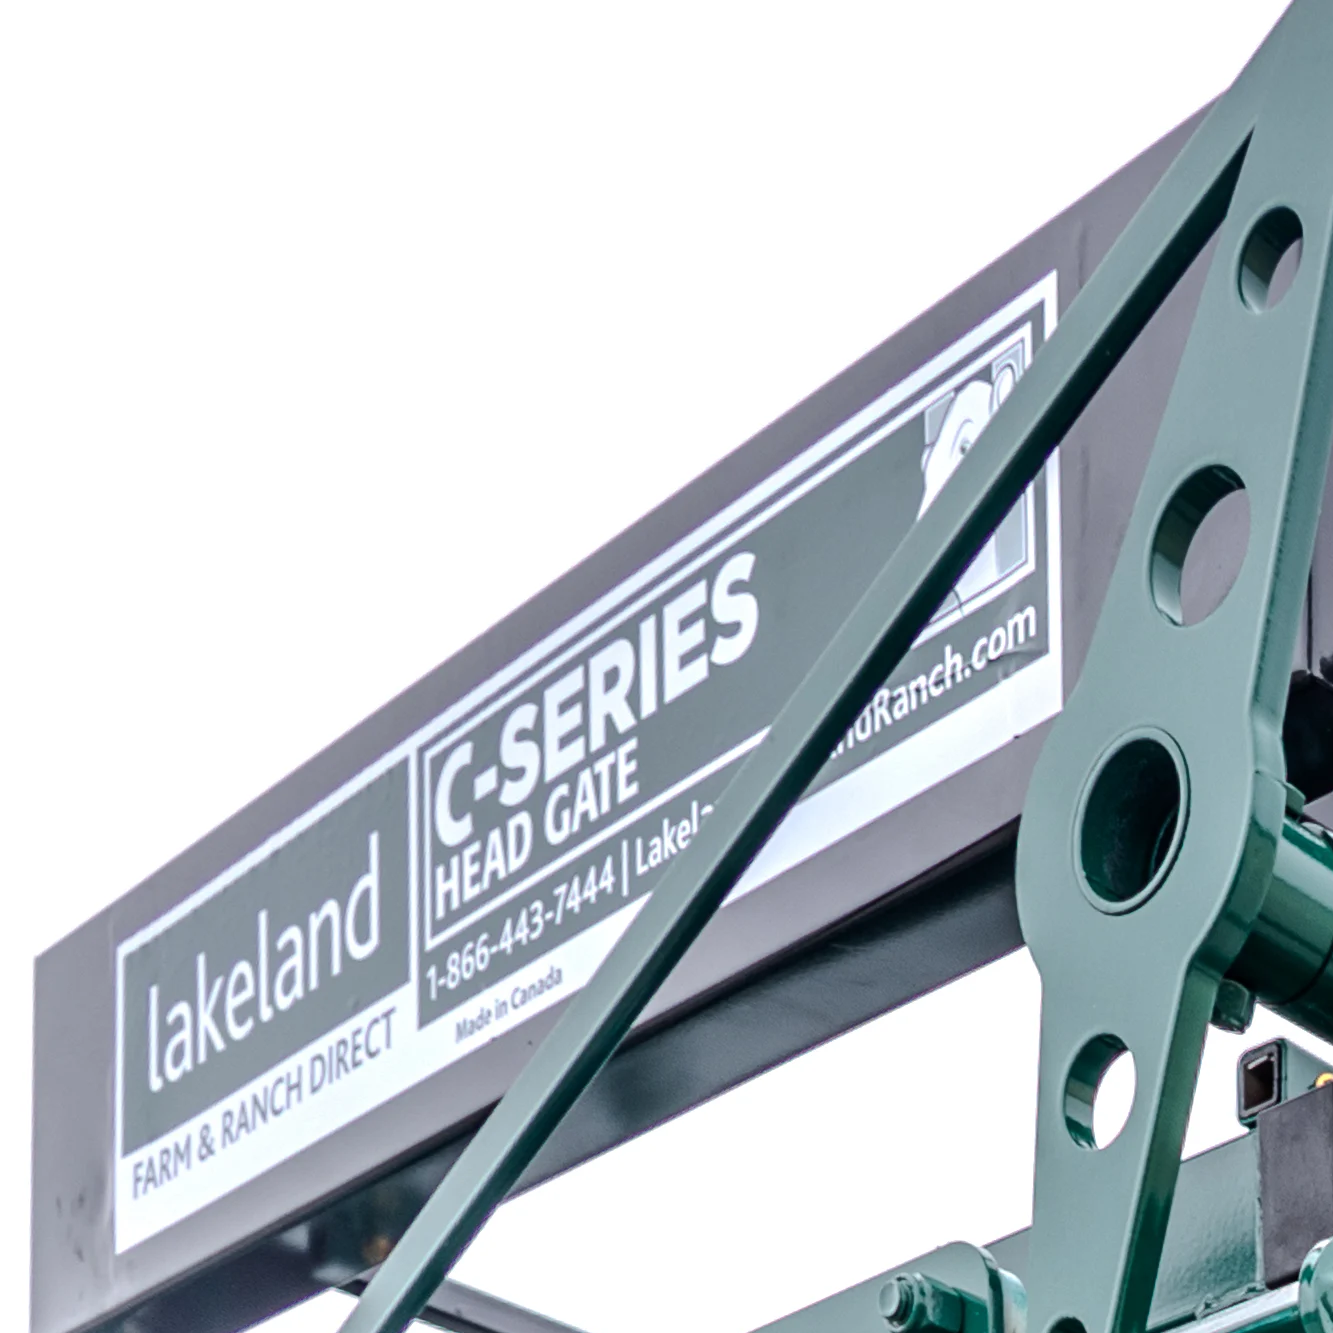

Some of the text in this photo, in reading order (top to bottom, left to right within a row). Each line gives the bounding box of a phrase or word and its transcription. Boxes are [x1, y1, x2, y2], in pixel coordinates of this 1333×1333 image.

[435, 551, 759, 847] C-SERIES
[435, 737, 639, 920] HEAD GATE
[147, 831, 380, 1093] lakeland
[426, 855, 615, 1000] 1-866-443-7444
[455, 965, 563, 1043] Made in Canada
[132, 1006, 397, 1199] FARM & RANCH DIRECT
